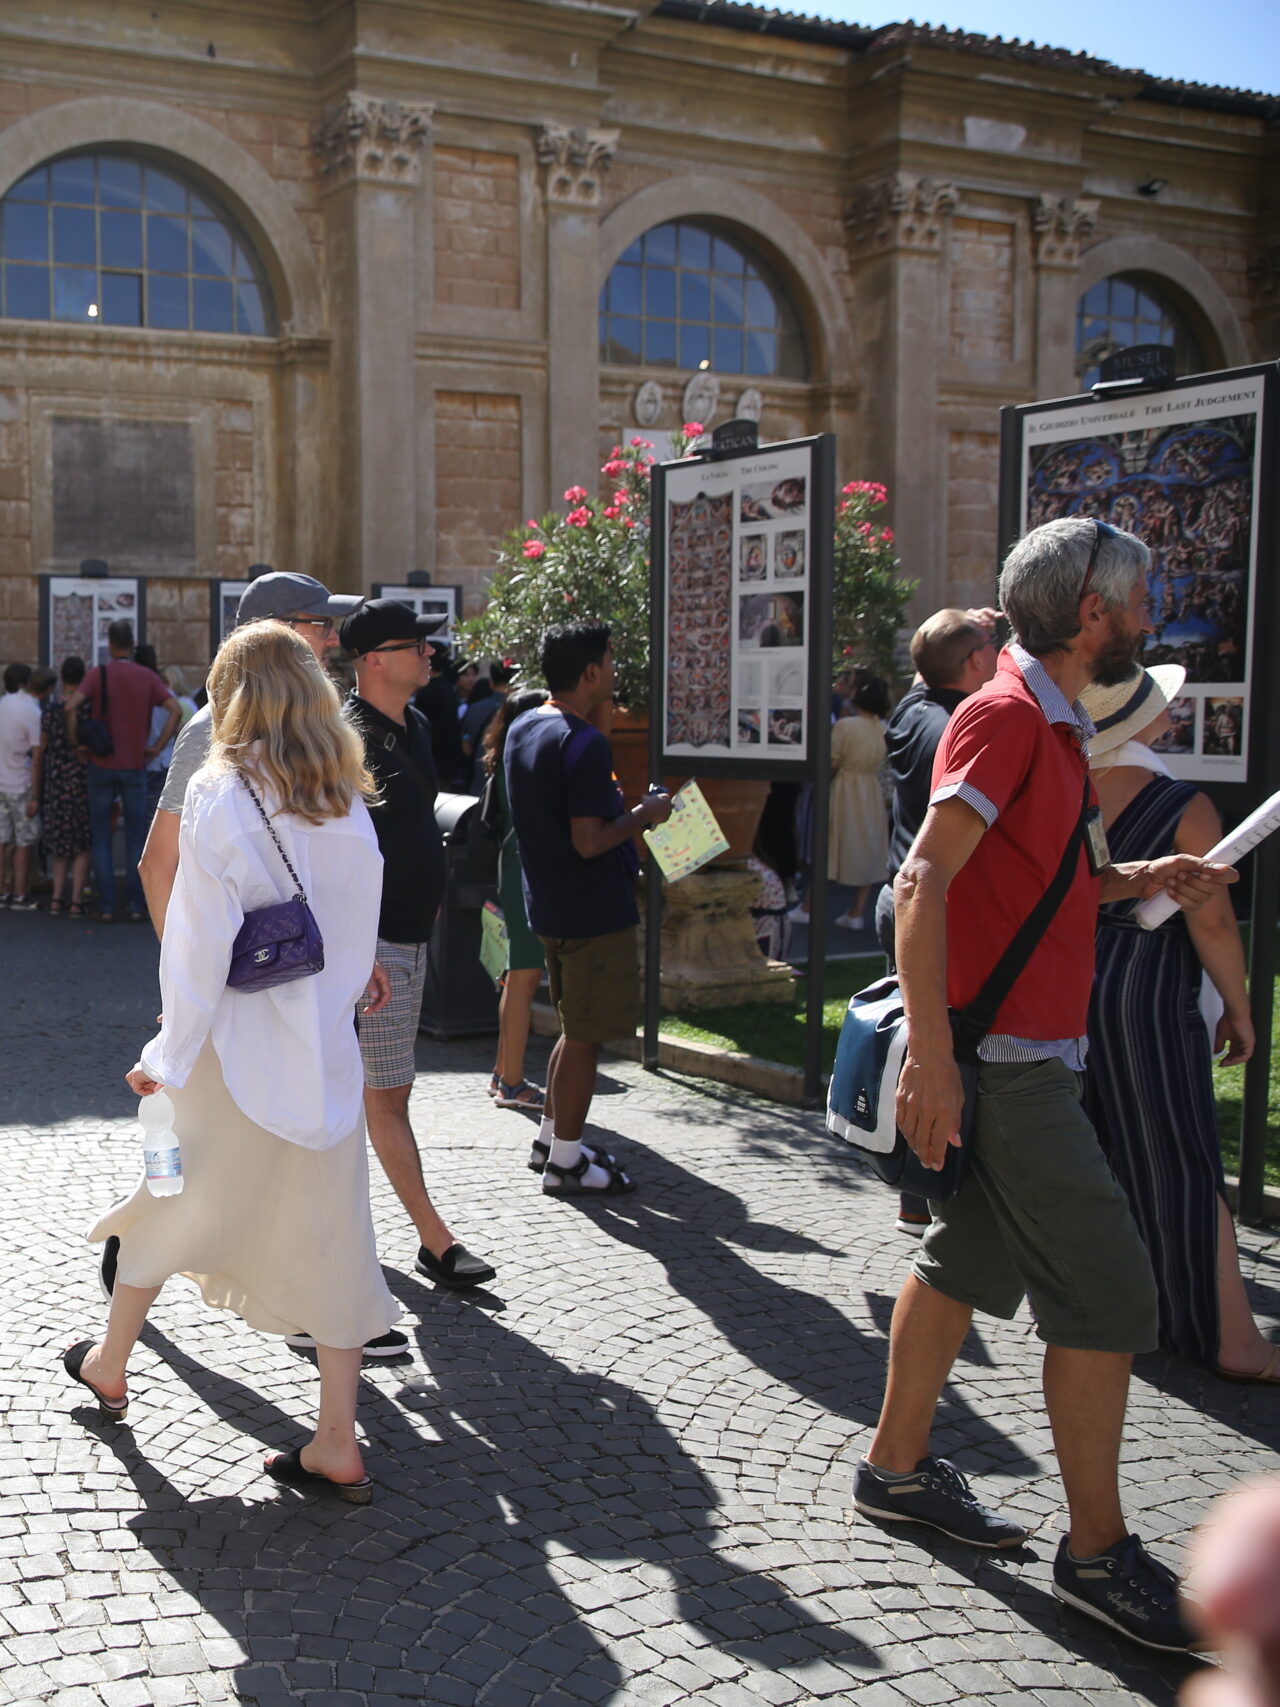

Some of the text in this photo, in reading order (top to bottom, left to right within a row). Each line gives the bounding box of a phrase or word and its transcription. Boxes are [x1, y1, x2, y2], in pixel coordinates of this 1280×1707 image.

[1080, 410, 1136, 426] UNIVERSALE
[1144, 405, 1163, 416] THE
[1167, 400, 1192, 412] LAST
[1194, 390, 1258, 408] JUDGEMENT
